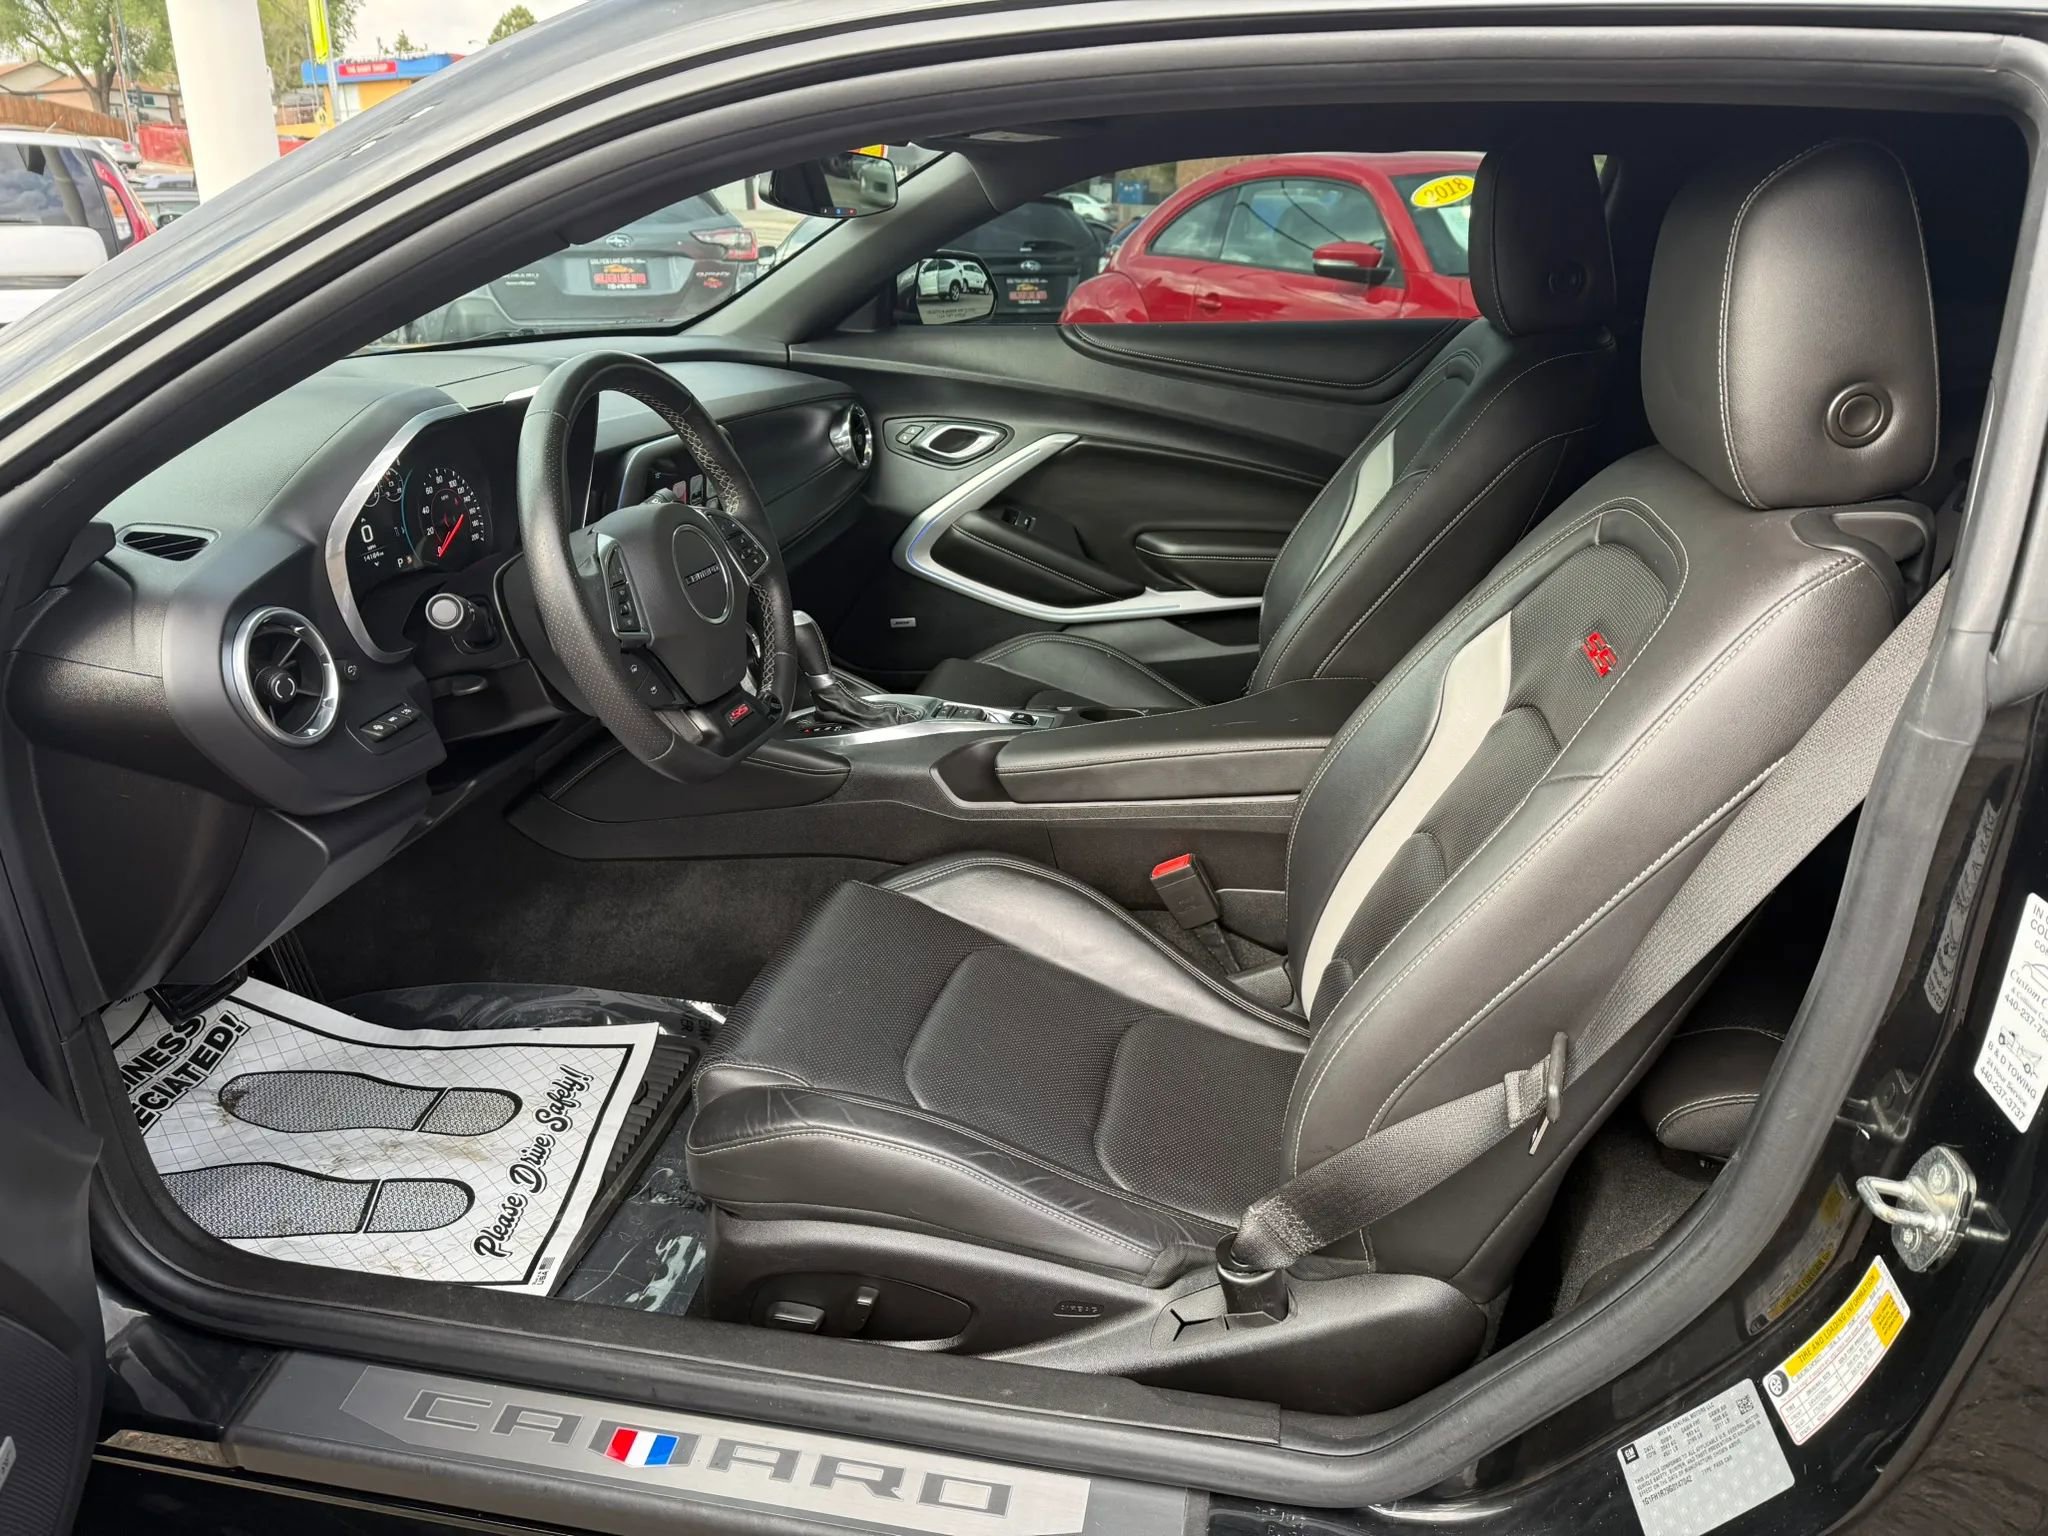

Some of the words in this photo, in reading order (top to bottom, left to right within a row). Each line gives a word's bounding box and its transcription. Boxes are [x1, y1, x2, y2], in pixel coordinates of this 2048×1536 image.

[1424, 177, 1468, 201] 2018
[422, 506, 430, 515] 40
[427, 526, 435, 536] 20
[1583, 631, 1617, 678] SS
[1988, 1041, 1994, 1051] B
[2000, 1054, 2007, 1065] D
[2007, 1061, 2037, 1100] TOWING
[1980, 1066, 2026, 1121] 440-237-3737
[472, 1192, 530, 1259] Please
[507, 1133, 557, 1195] Drive
[1811, 1336, 1825, 1350] AND
[1823, 1312, 1848, 1341] LOADING
